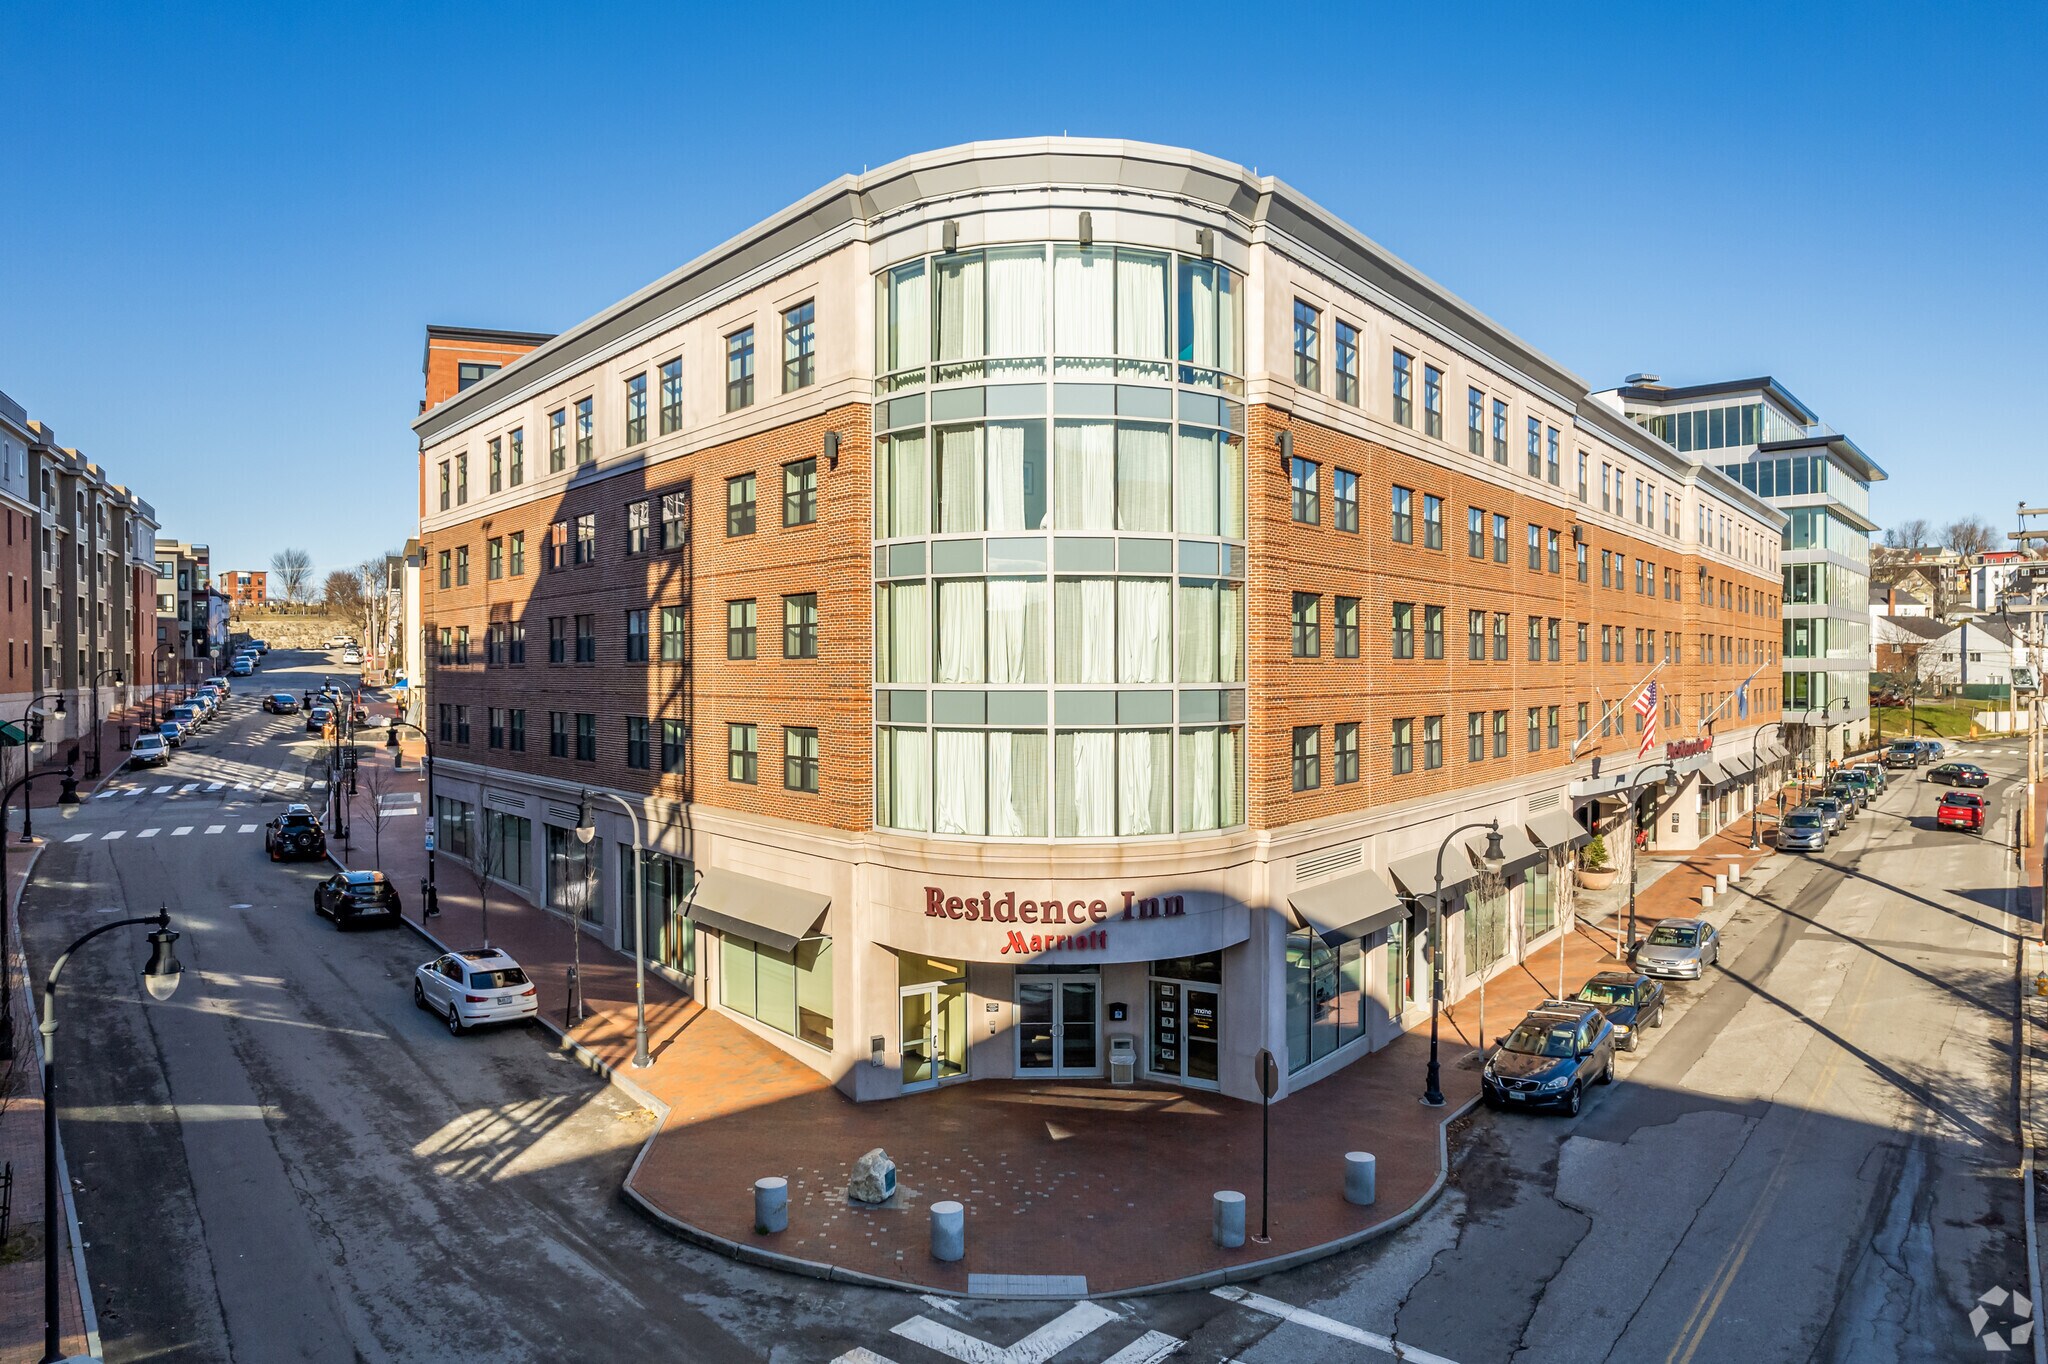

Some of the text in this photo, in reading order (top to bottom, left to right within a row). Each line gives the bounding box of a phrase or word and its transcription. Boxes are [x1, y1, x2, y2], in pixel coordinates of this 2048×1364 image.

[924, 886, 1186, 924] Residence Inn
[1000, 929, 1107, 954] Marriott
